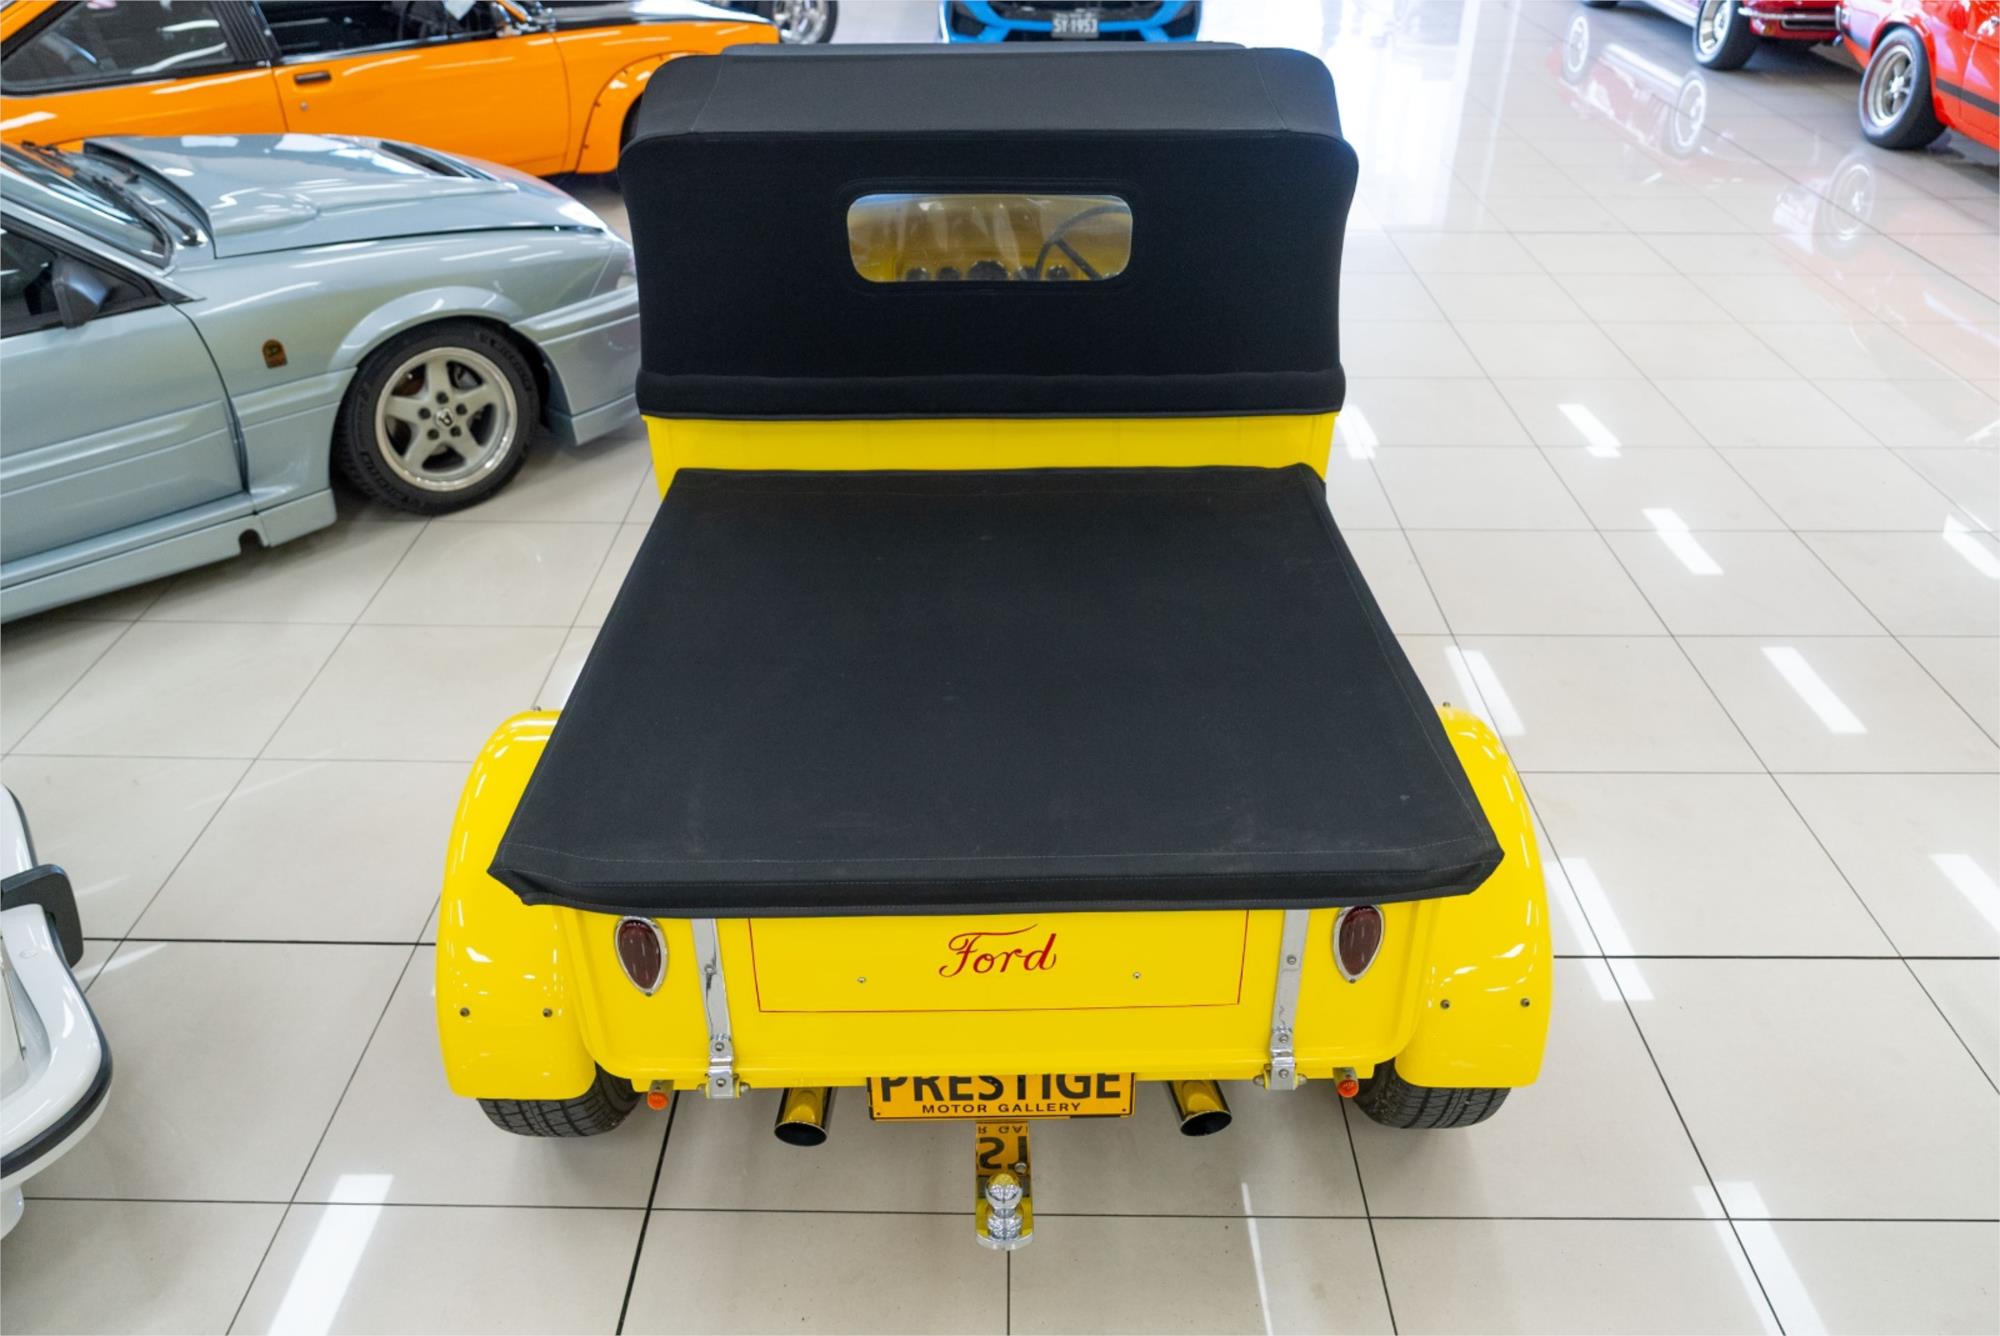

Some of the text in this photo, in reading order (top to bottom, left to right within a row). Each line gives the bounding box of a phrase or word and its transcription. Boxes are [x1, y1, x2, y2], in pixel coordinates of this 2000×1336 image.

[938, 923, 1057, 978] Ford
[922, 1102, 1081, 1114] MOTOR GALLERY
